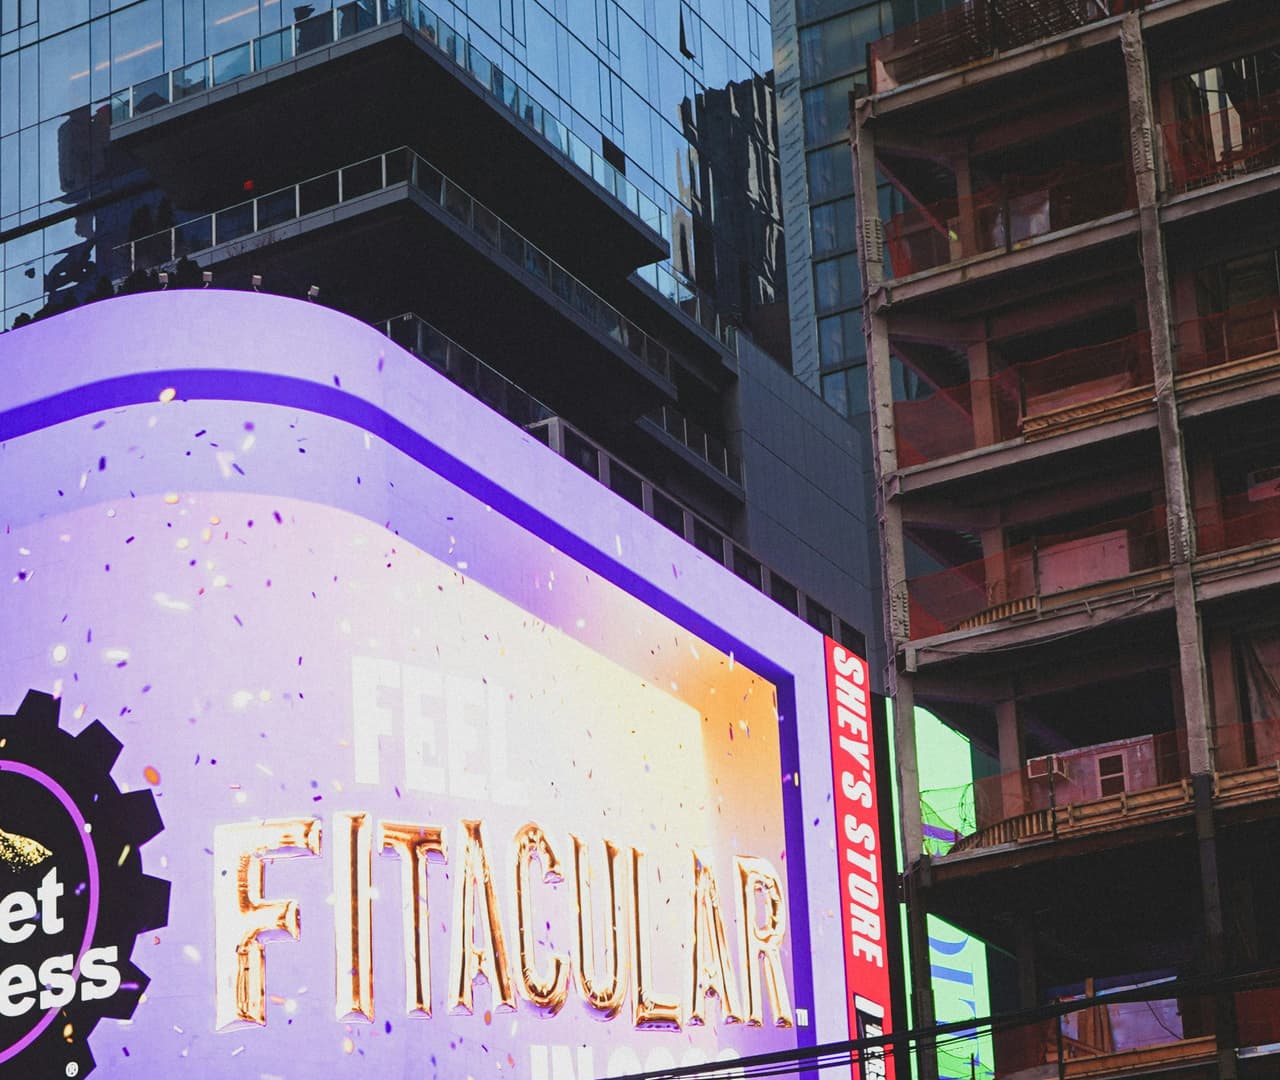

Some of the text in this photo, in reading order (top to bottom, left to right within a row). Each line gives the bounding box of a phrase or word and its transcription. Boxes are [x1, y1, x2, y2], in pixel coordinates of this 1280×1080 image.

[351, 655, 532, 805] FEEL
[833, 646, 884, 968] SHEY'S STORE
